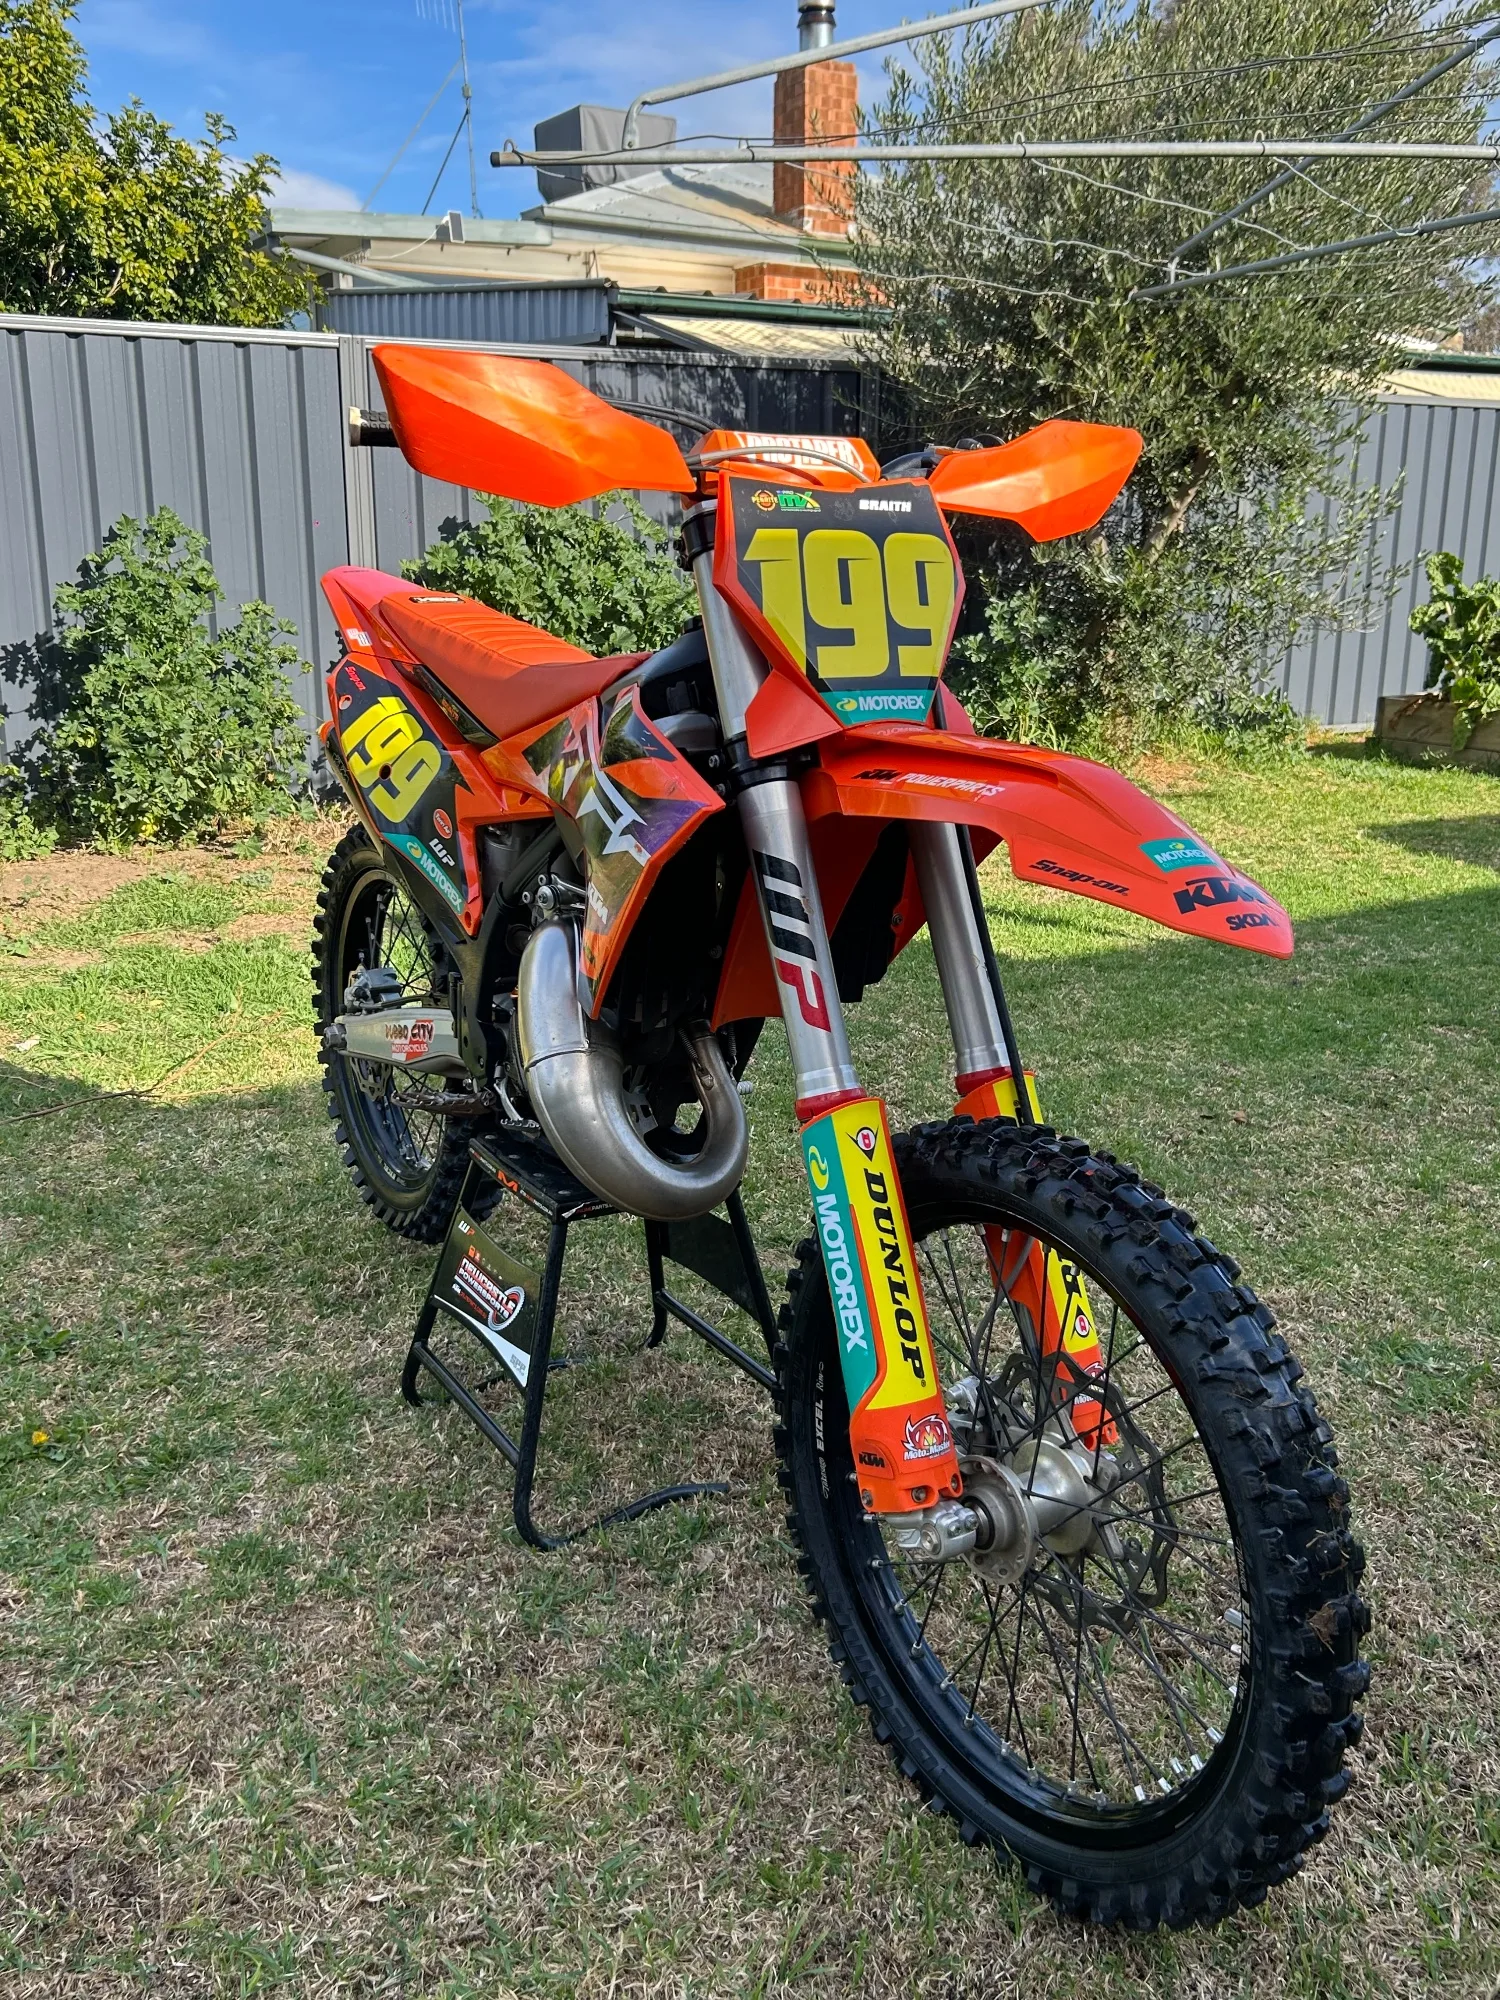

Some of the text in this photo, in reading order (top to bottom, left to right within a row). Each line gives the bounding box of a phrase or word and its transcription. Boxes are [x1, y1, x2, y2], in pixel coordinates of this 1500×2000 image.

[859, 499, 912, 512] BRAITH
[743, 528, 955, 678] 199
[859, 695, 925, 711] MOTOREX
[341, 696, 441, 823] 199
[850, 768, 1005, 797] KTM POWERPARTS
[1154, 849, 1209, 863] MOTOREX
[420, 853, 462, 911] MOTOREX
[1029, 859, 1129, 894] Snap-on
[588, 882, 608, 924] KTM
[1173, 877, 1269, 914] KTM
[1225, 913, 1279, 931] SKDA
[391, 1043, 429, 1052] MOTORCYCLES
[411, 1022, 435, 1042] CITY
[461, 1258, 516, 1312] NEWCASTLE
[816, 1193, 868, 1354] MOTOREX
[863, 1167, 925, 1381] DUNLOP
[459, 1268, 510, 1319] POWERSPORTS
[815, 1400, 824, 1451] EXCEL
[858, 1452, 885, 1468] KTM
